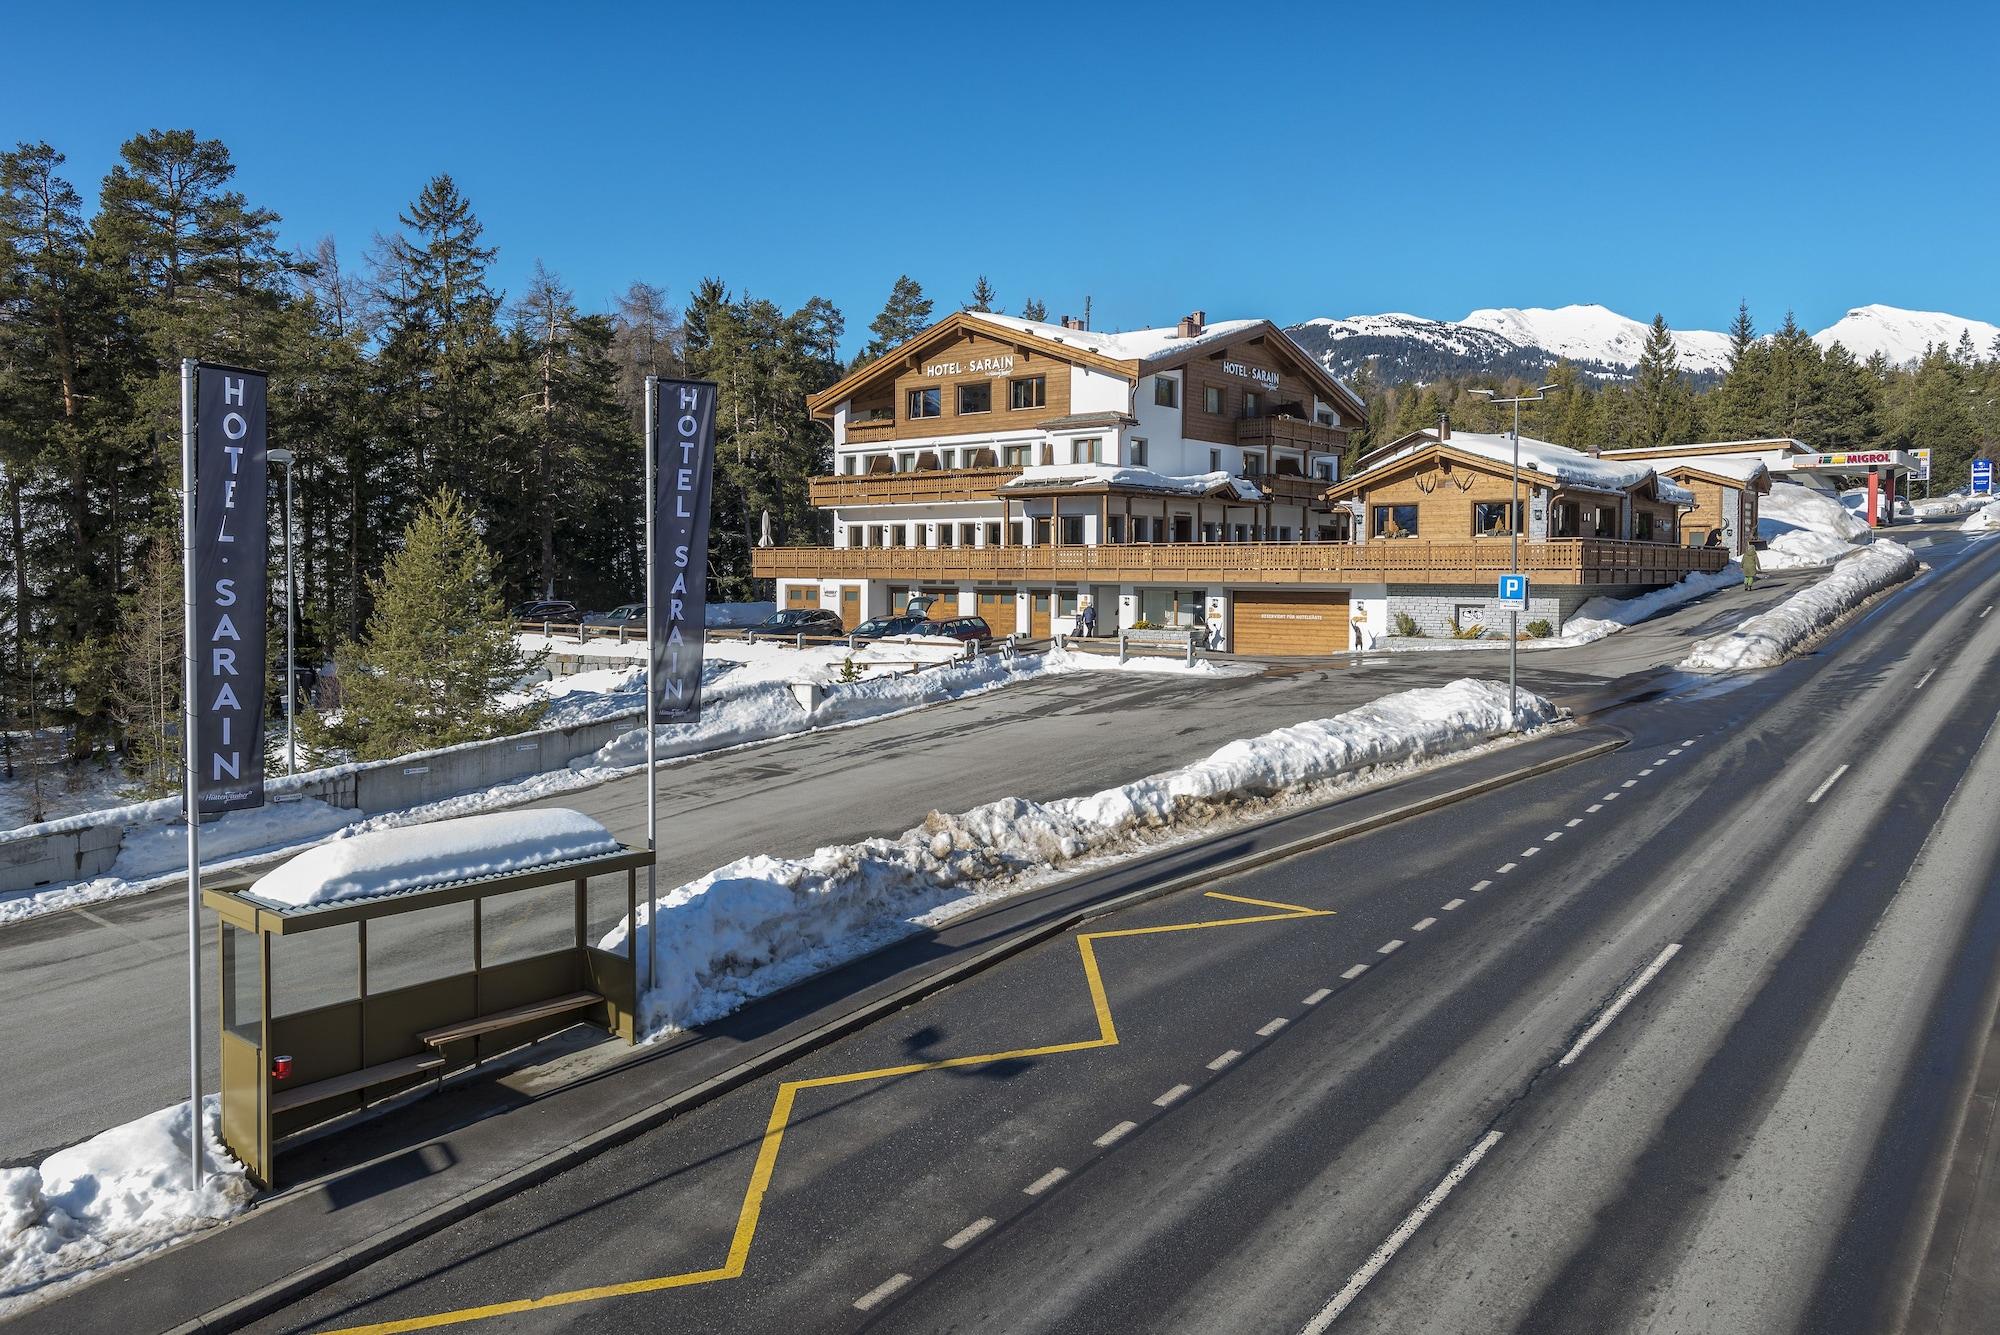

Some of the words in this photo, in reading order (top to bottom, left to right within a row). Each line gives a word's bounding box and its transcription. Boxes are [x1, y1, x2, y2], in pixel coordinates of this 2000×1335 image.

[927, 362, 962, 377] HOTEL
[969, 356, 1014, 372] SARAIN
[1223, 361, 1248, 377] HOTEL
[1251, 367, 1280, 384] SARAIN
[218, 376, 247, 542] HOTEL
[676, 387, 698, 518] HOTEL
[1846, 453, 1891, 464] MIGROL
[664, 545, 689, 700] SARAIN
[1506, 579, 1519, 597] P
[211, 578, 242, 781] SARAIN
